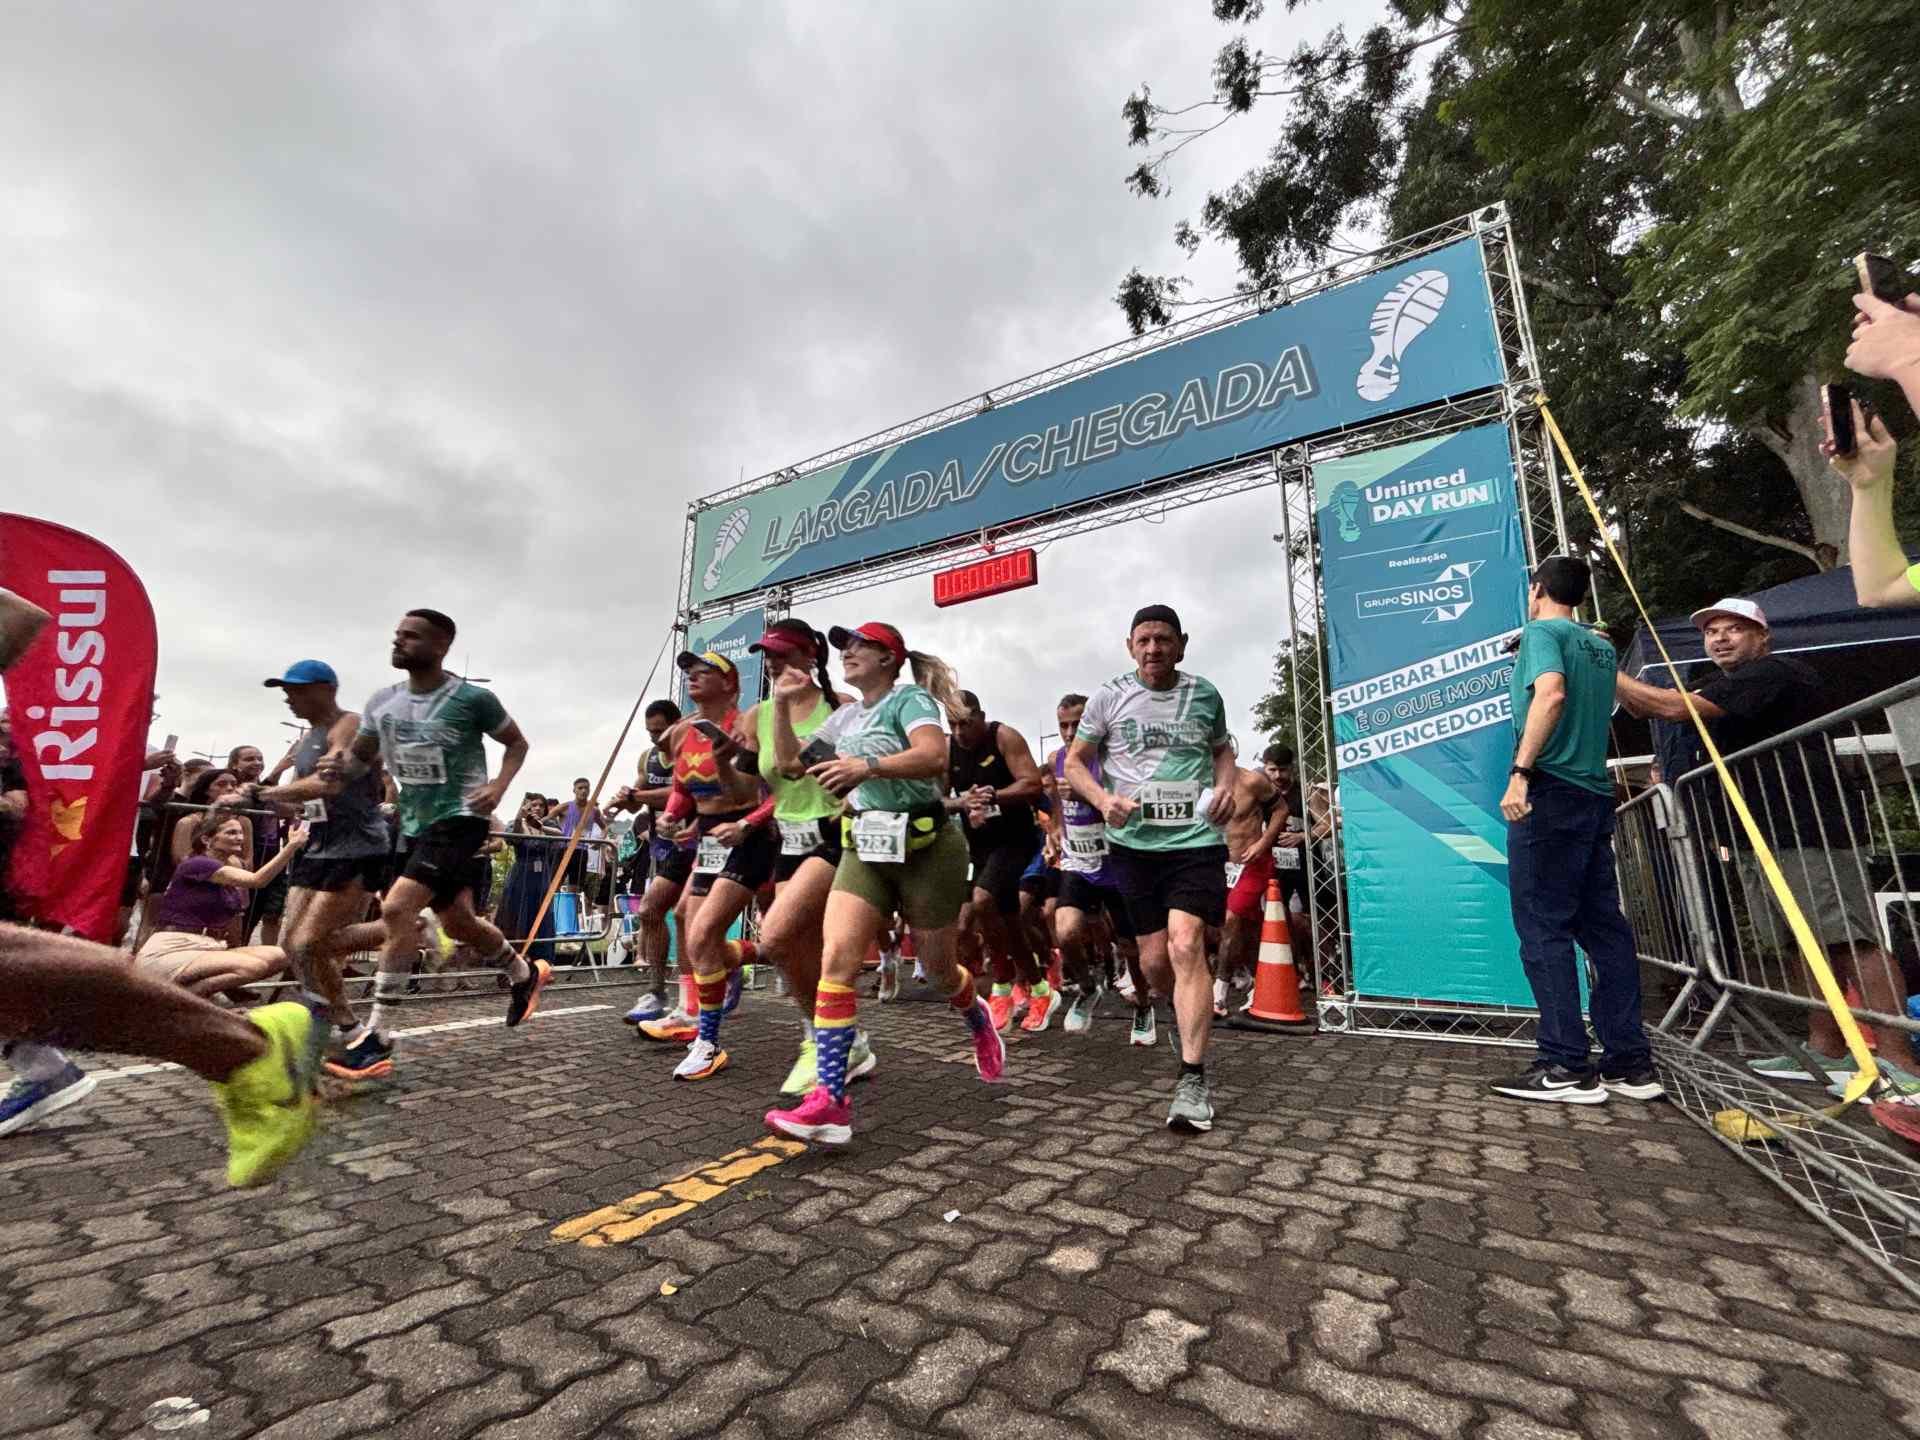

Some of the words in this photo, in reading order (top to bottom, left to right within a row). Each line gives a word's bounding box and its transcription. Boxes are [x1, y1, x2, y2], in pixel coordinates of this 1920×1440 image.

[760, 345, 1317, 562] LARGADA/CHEGADA
[1364, 468, 1467, 503] Unimed
[1372, 497, 1426, 523] DAY
[1431, 485, 1489, 511] RUN
[1388, 552, 1448, 568] Realização
[1364, 597, 1400, 608] GRUPO
[1400, 585, 1464, 606] SINOS
[706, 634, 746, 652] Unimed
[26, 570, 106, 780] Rissul
[1337, 664, 1435, 709] SUPERAR
[1442, 636, 1514, 674] LIMIT
[1356, 711, 1371, 733] É
[1373, 708, 1391, 727] O
[1395, 690, 1443, 720] QUE
[1447, 666, 1513, 705] MOVE
[1342, 742, 1371, 763] OS
[1374, 700, 1512, 749] VENCEDORE
[1151, 803, 1187, 818] 1132
